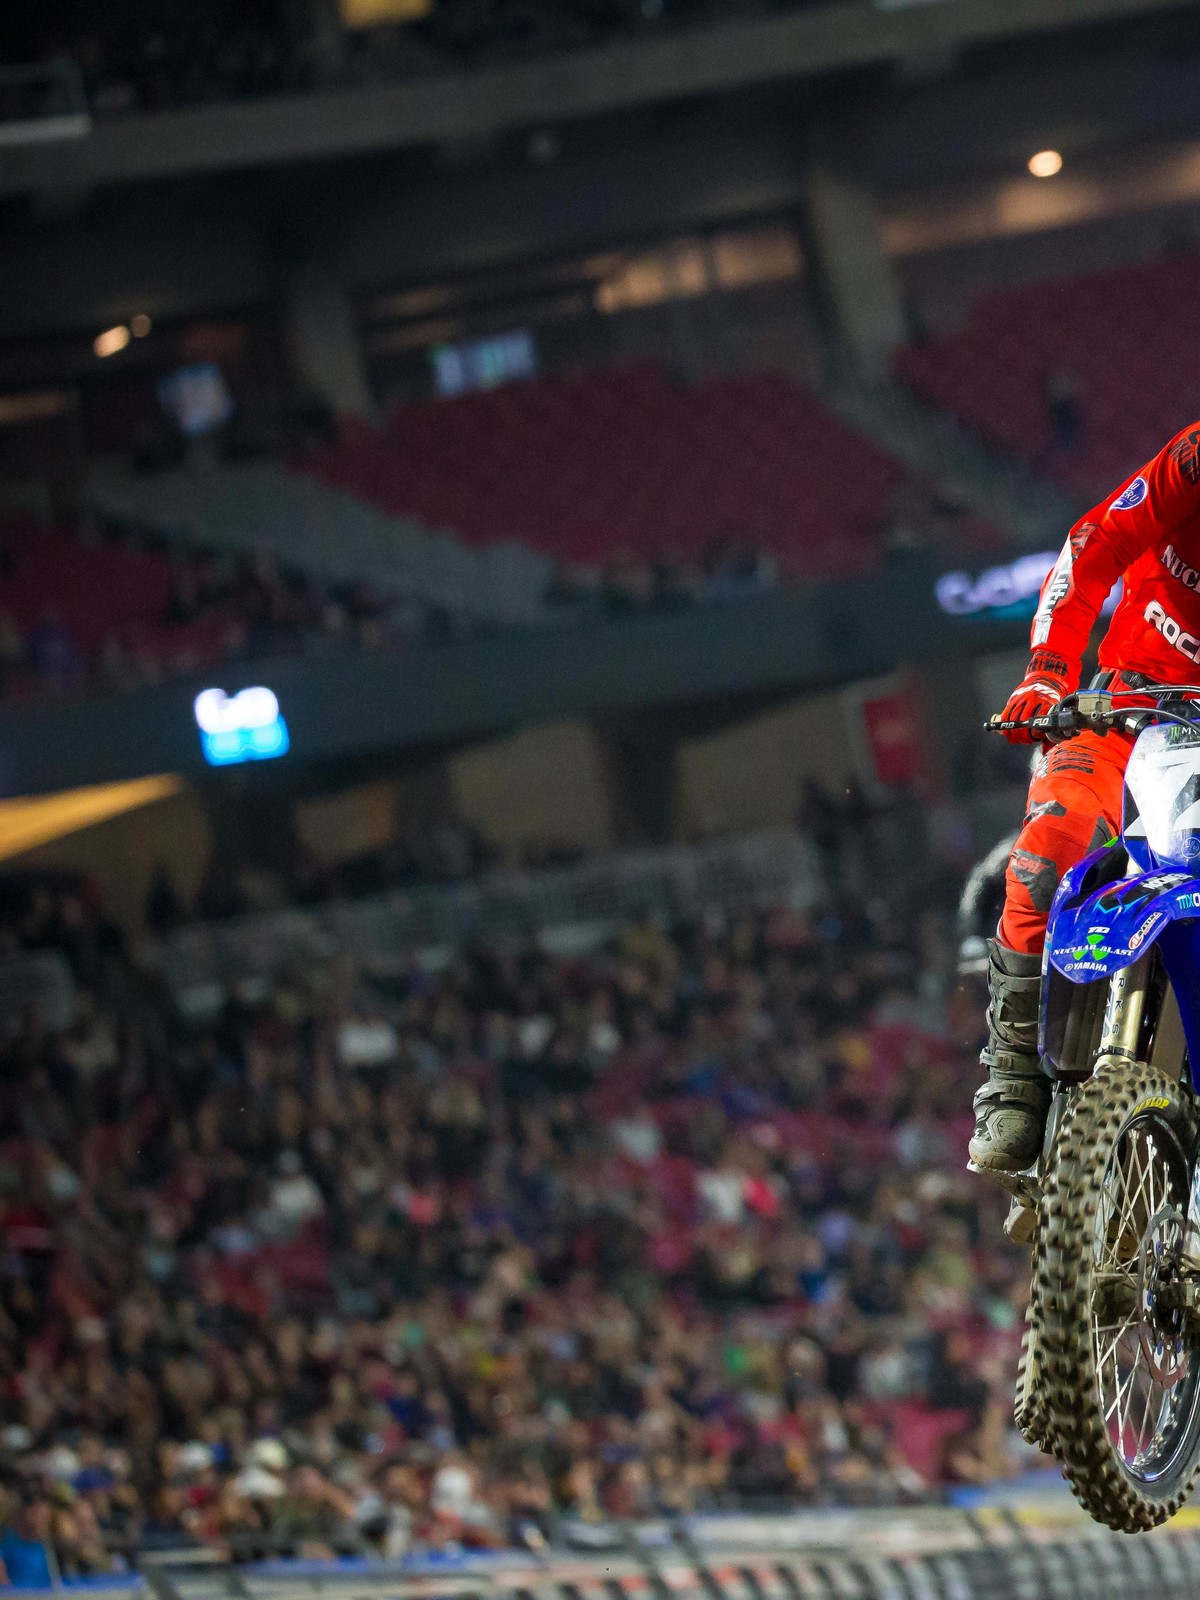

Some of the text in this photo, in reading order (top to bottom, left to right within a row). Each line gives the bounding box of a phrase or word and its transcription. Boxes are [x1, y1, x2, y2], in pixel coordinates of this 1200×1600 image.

[1033, 717, 1050, 727] FLO
[1053, 944, 1134, 957] NUCLEAR BLAST
[1073, 962, 1108, 972] YAMAHA
